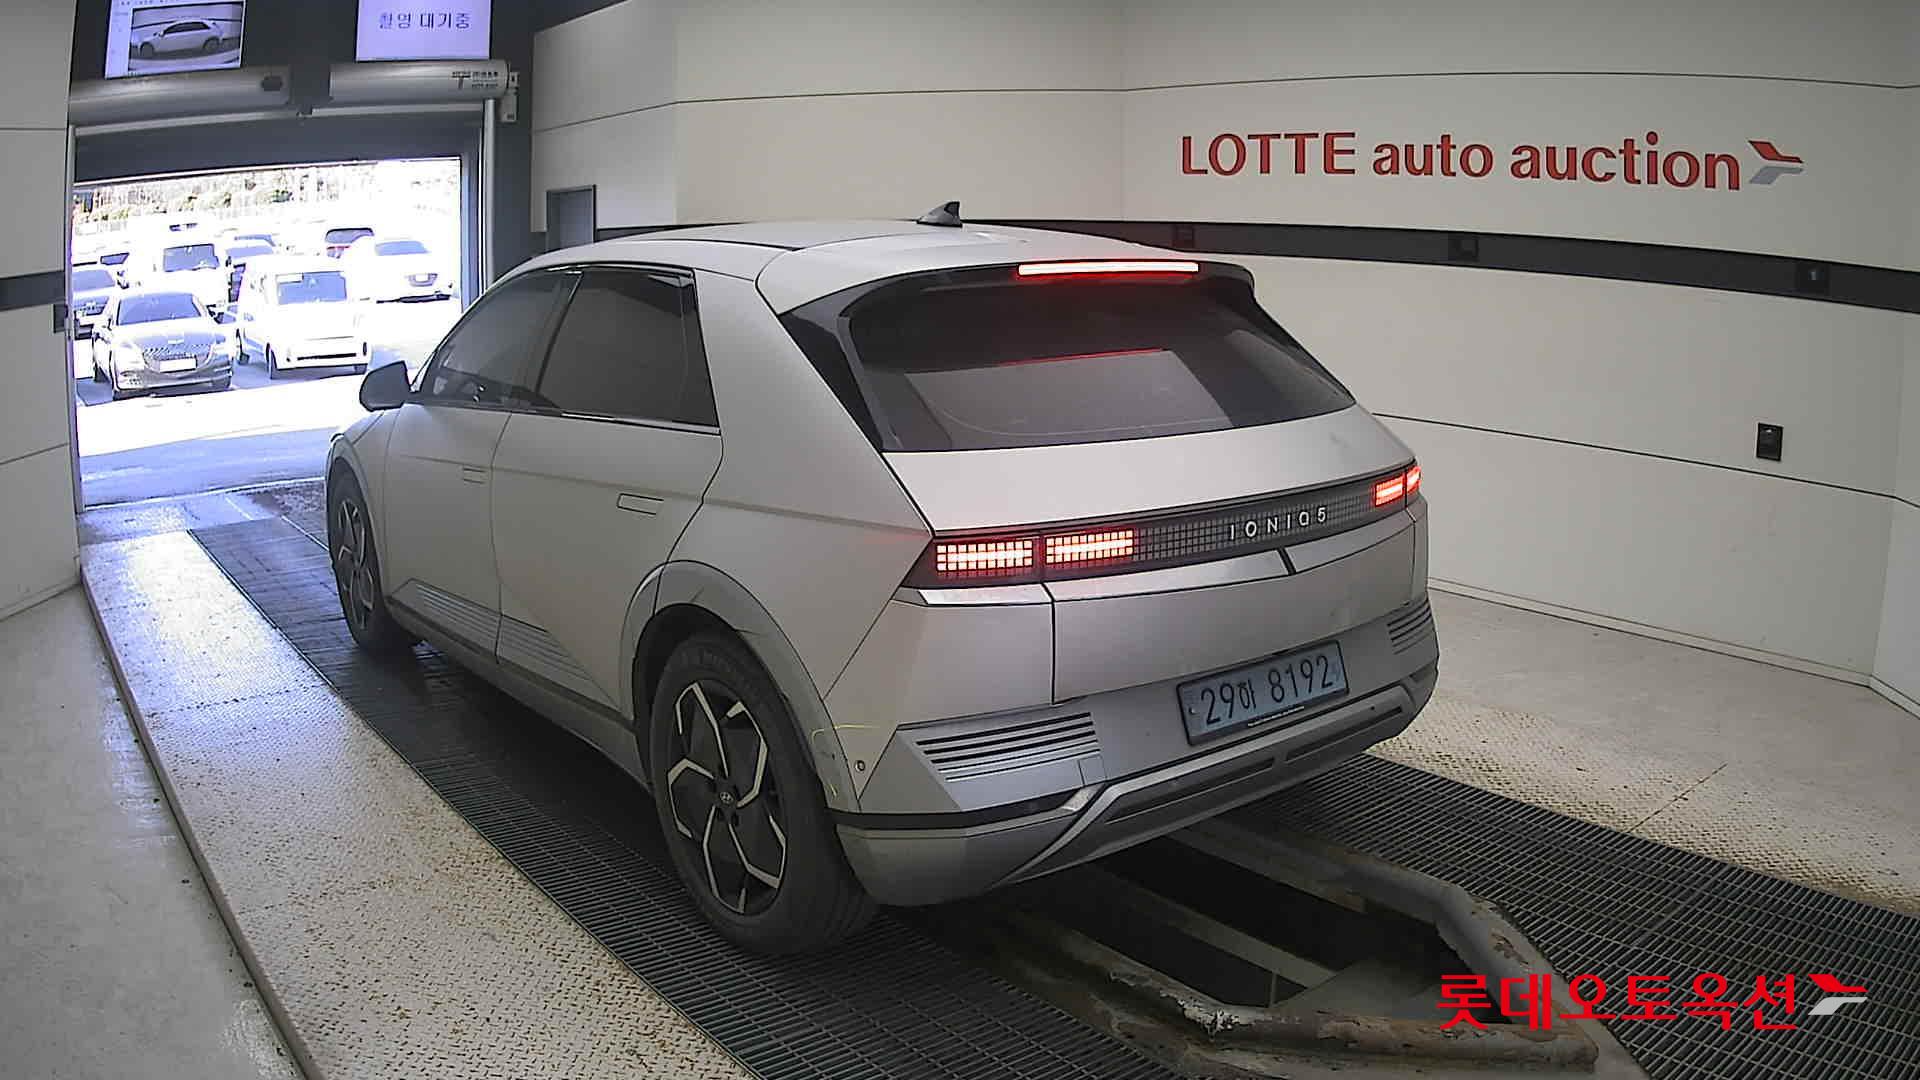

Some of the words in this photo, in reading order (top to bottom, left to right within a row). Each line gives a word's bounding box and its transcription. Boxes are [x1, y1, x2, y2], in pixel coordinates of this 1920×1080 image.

[419, 11, 470, 29] 대기중
[1181, 131, 1357, 177] LOTTE
[1372, 134, 1496, 178] auto
[1510, 131, 1742, 191] auction
[1267, 654, 1334, 703] 8192
